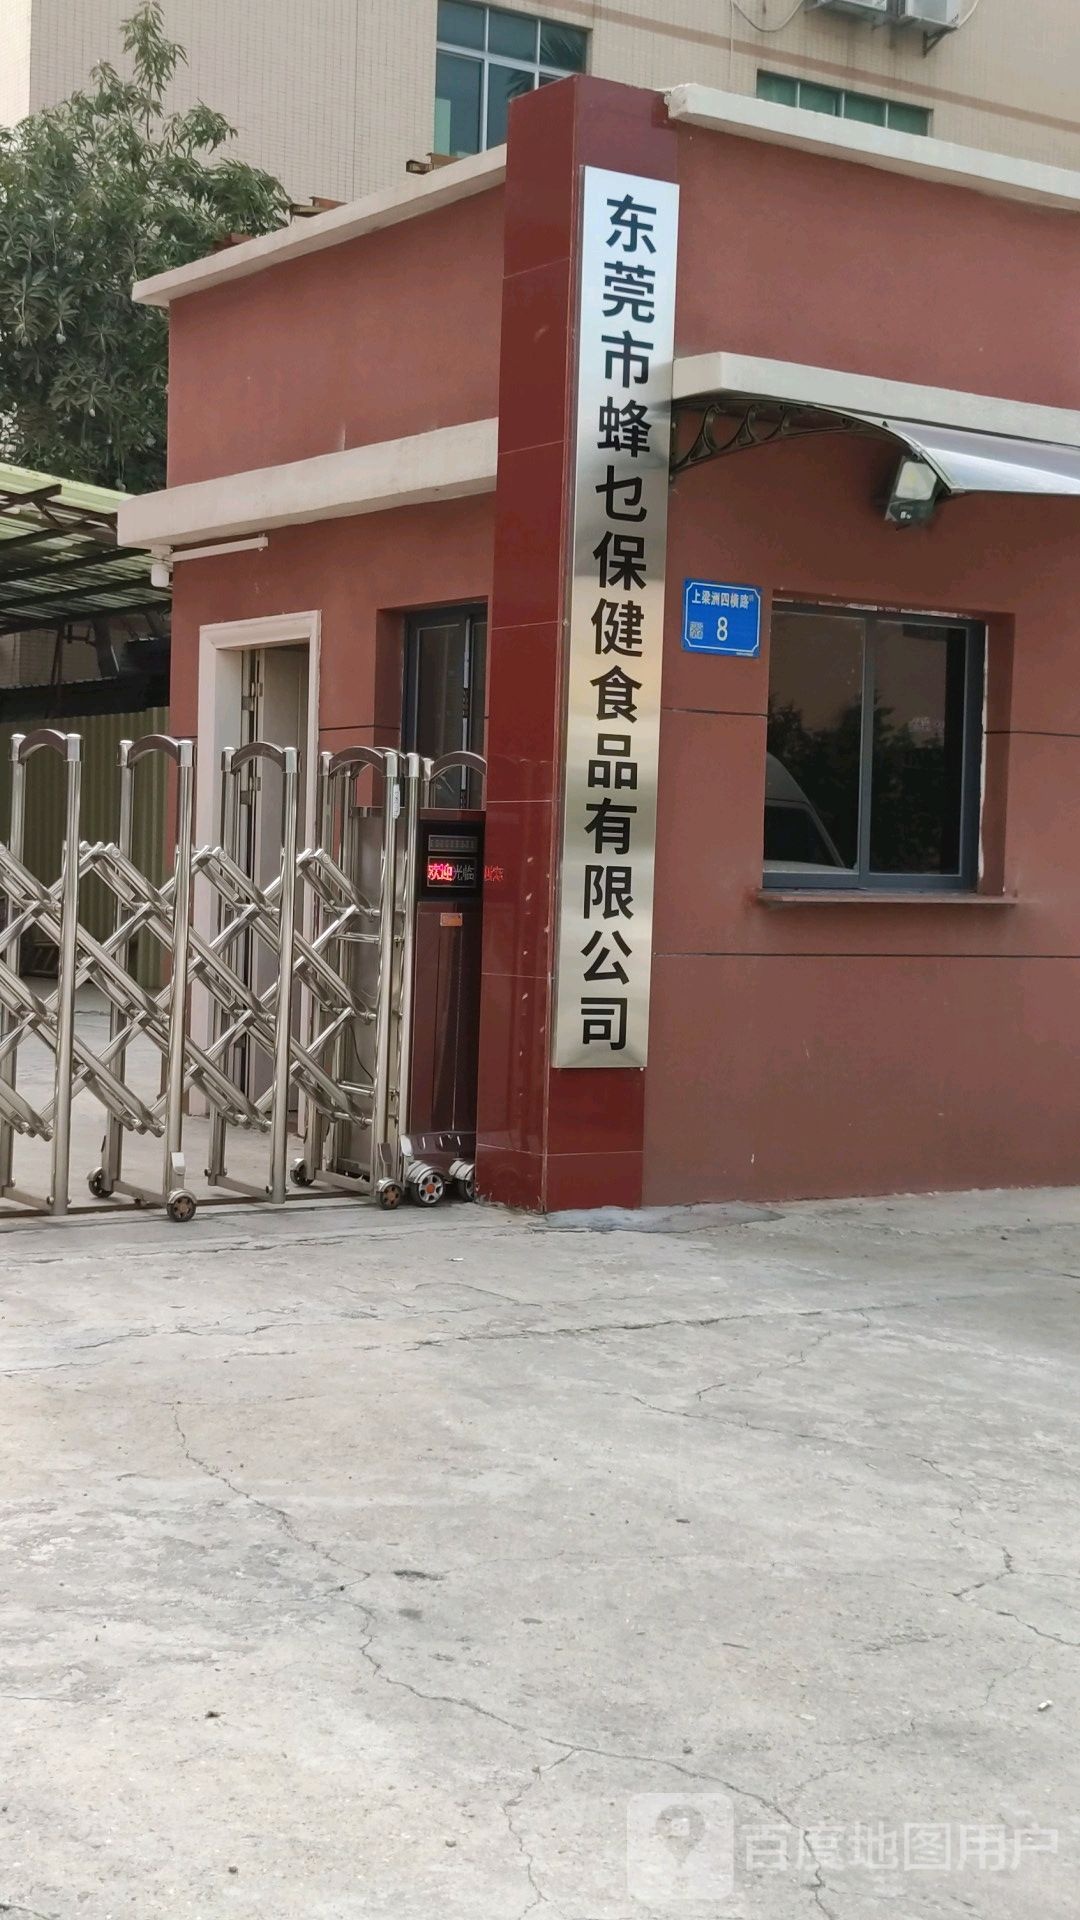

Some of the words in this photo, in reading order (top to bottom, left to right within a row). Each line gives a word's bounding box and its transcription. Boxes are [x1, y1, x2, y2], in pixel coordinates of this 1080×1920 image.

[580, 194, 657, 1050] 东莞市蜂乜保健食品有限公司
[716, 616, 728, 641] 8
